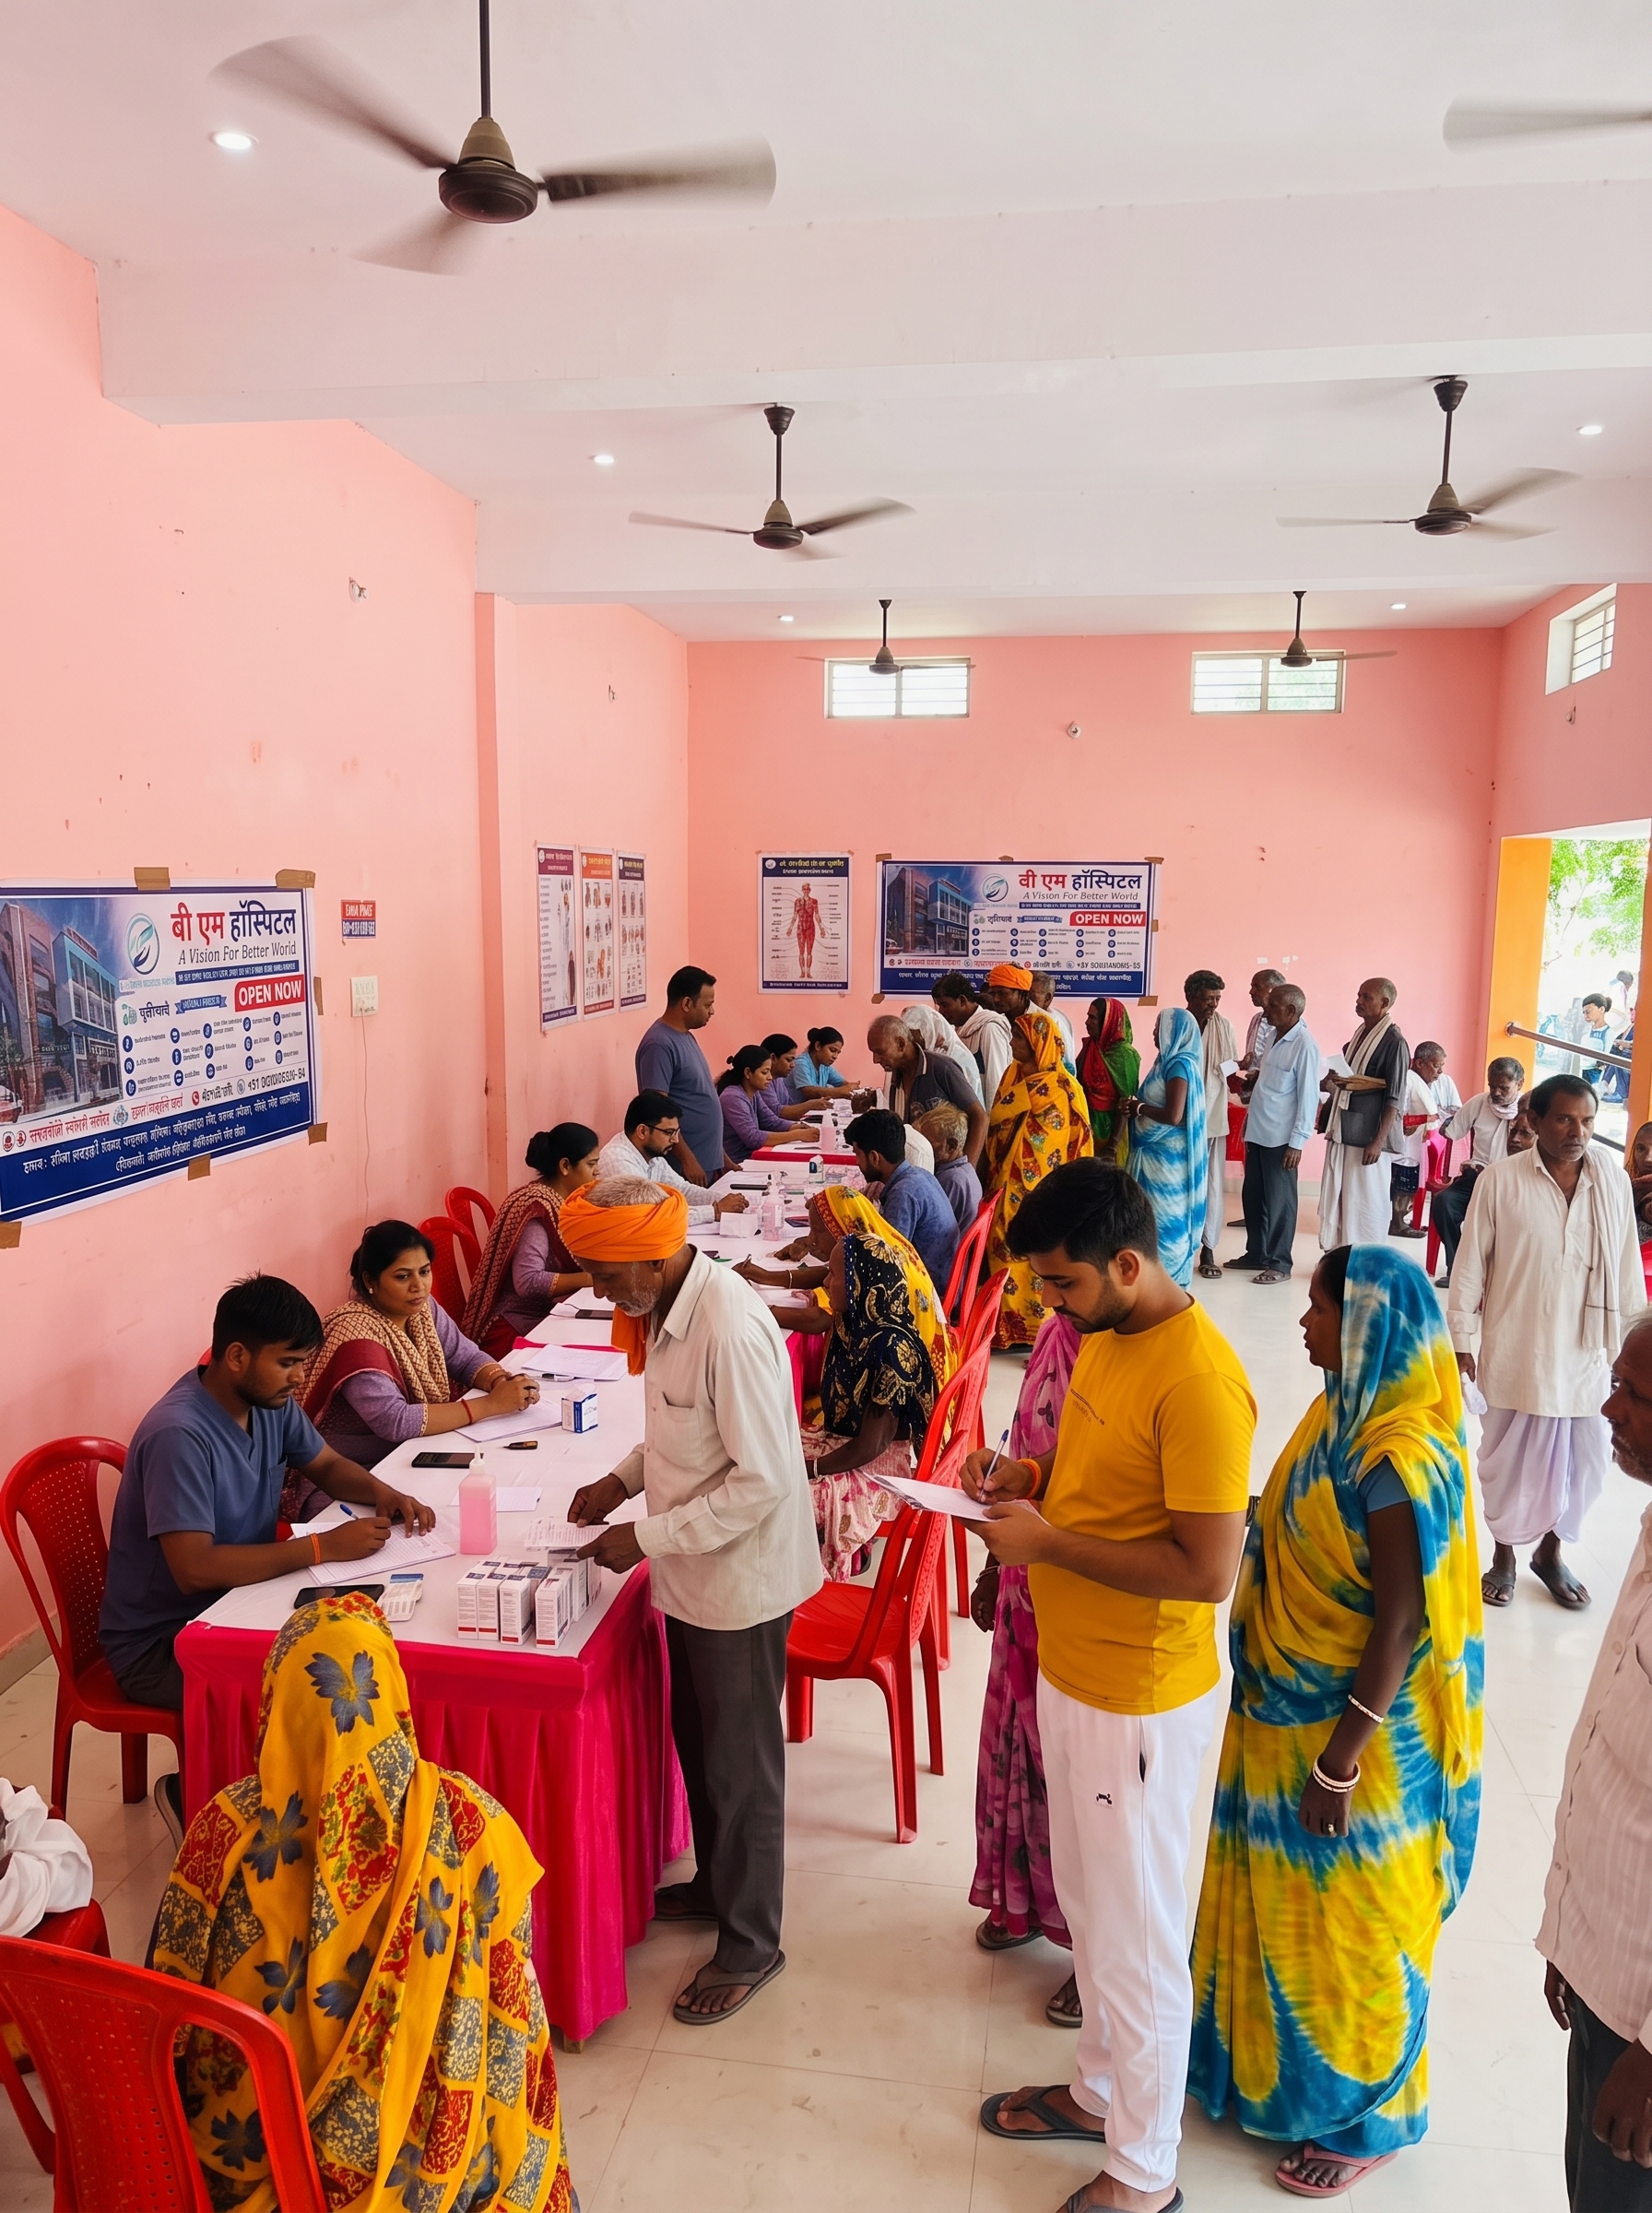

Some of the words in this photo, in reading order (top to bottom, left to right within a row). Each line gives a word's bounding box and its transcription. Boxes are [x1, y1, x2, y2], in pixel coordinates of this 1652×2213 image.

[1041, 874, 1068, 892] एम
[1071, 870, 1142, 892] हॉस्पिटल
[1023, 892, 1030, 900] A
[1080, 892, 1109, 900] Better
[1111, 892, 1139, 901] World
[171, 902, 192, 941] बी
[196, 912, 225, 946] एम
[230, 900, 296, 942] हॉस्पिटल
[1075, 914, 1111, 925] OPEN
[1113, 914, 1144, 925] NOW
[178, 949, 186, 965] A
[189, 948, 220, 964] Vision
[223, 945, 240, 961] For
[242, 944, 269, 959] Better
[271, 941, 296, 956] World
[239, 983, 272, 1006] OPEN
[275, 979, 302, 1002] NOW
